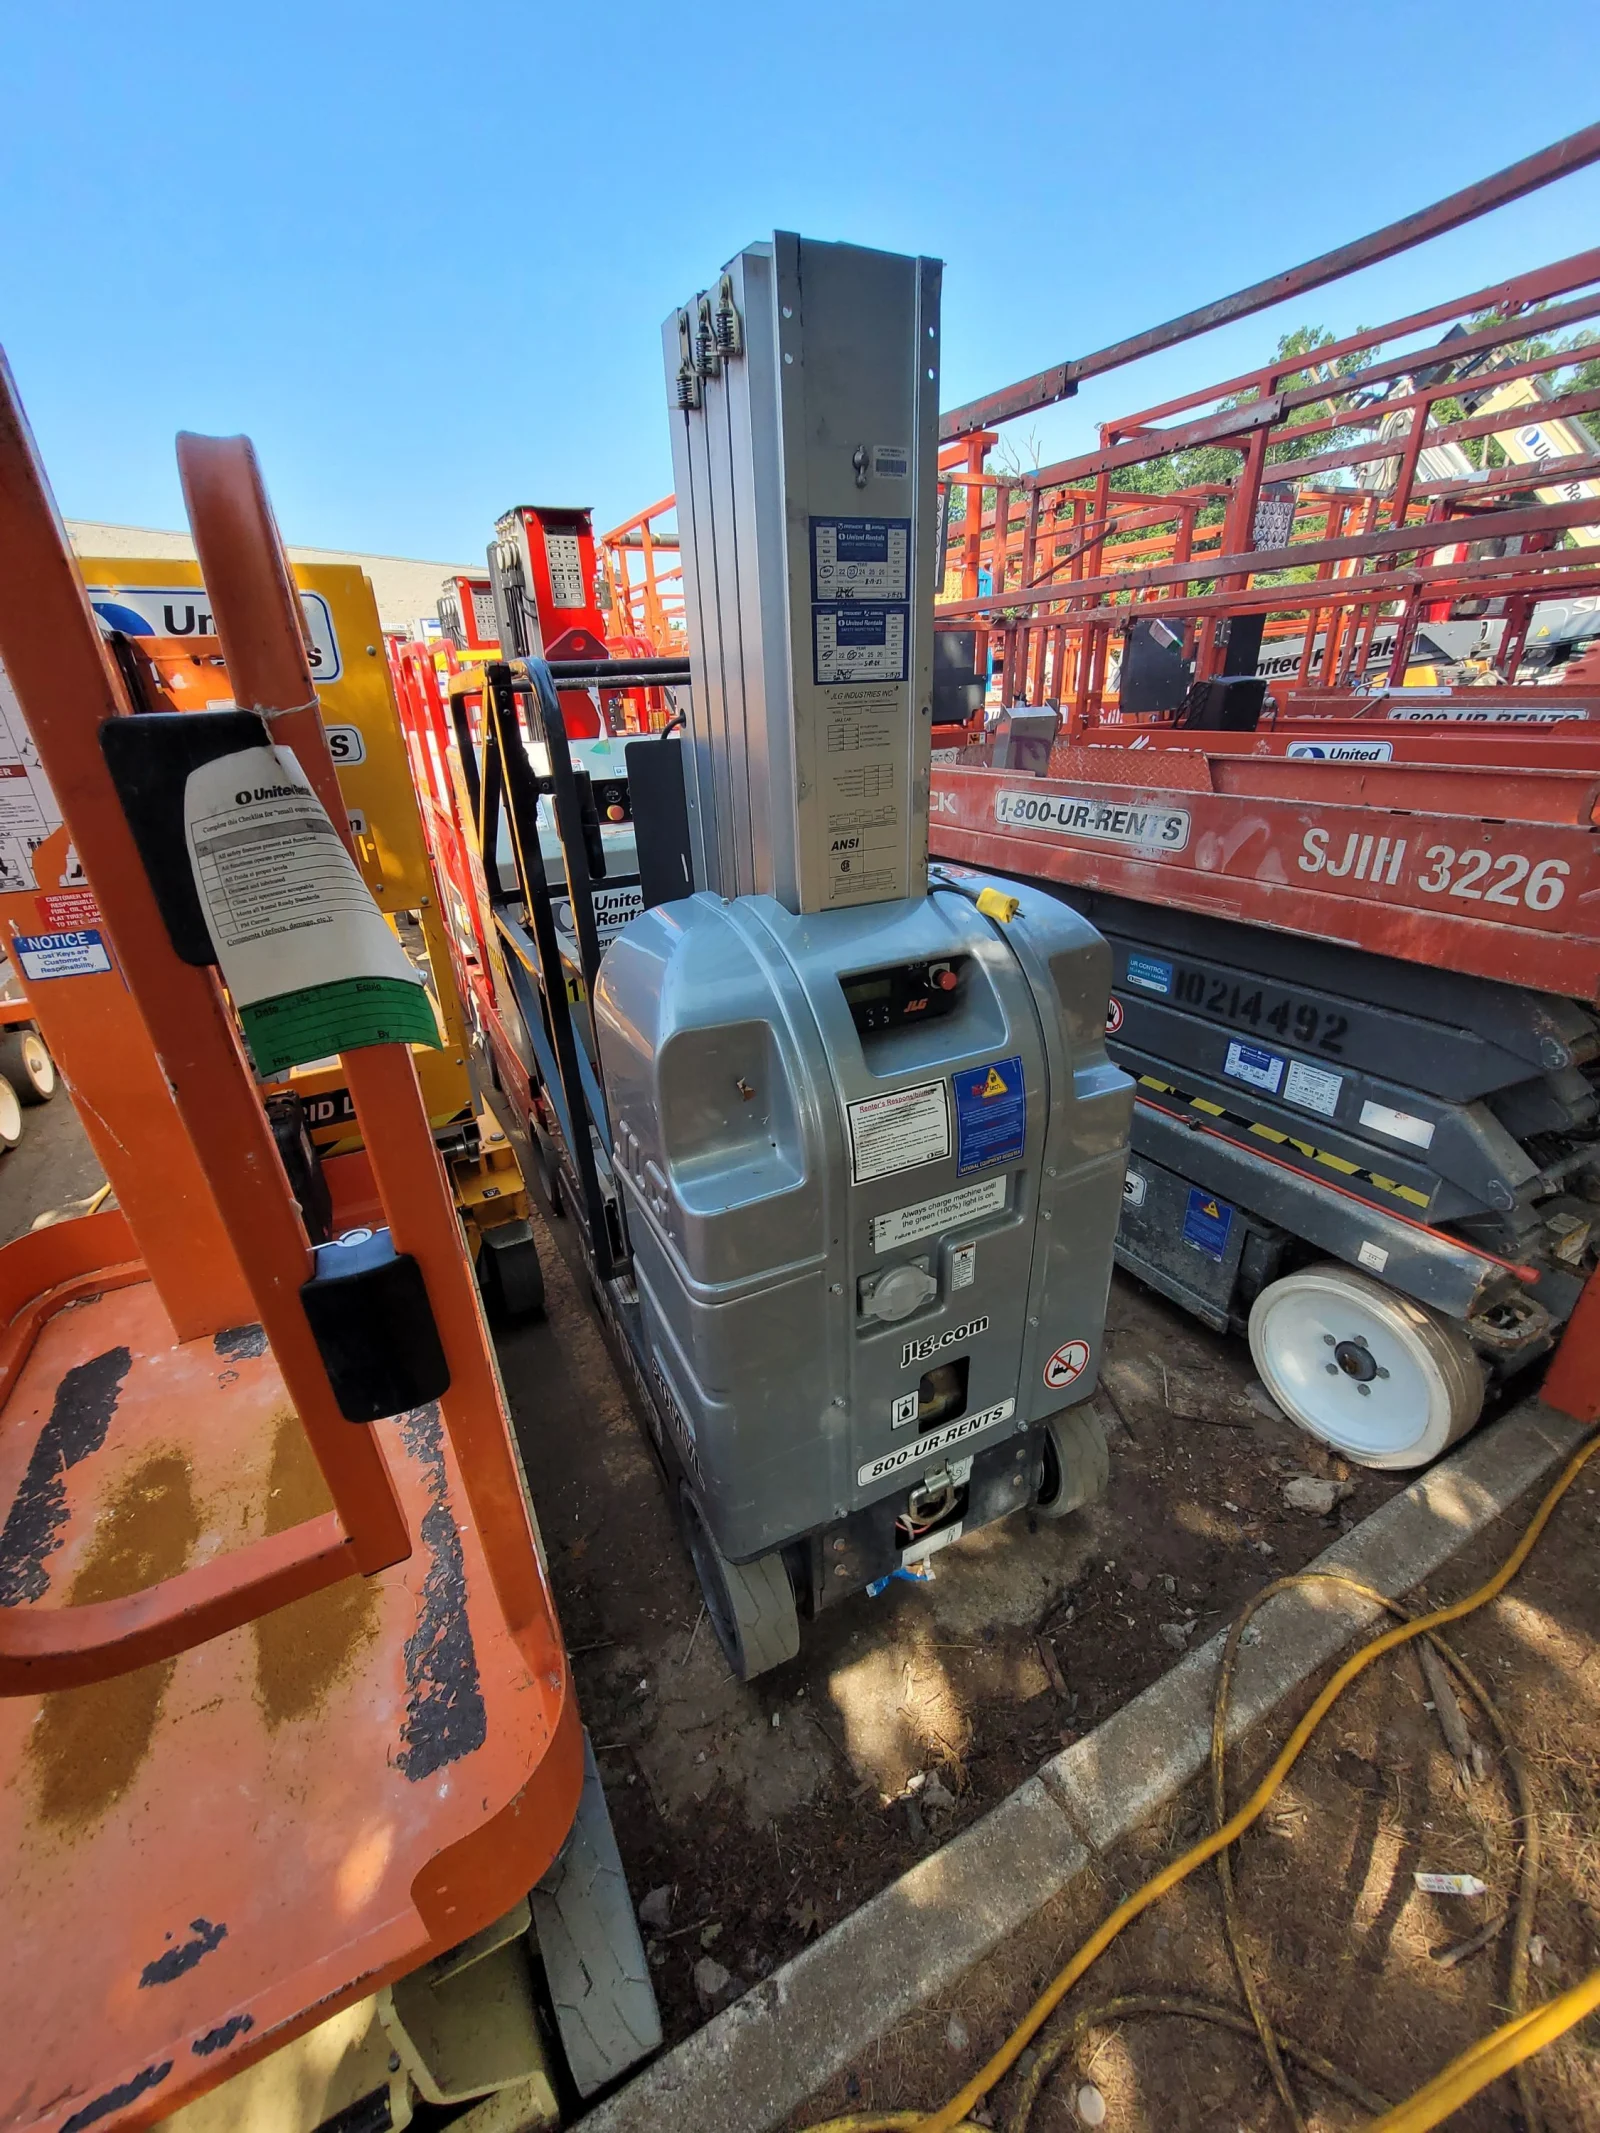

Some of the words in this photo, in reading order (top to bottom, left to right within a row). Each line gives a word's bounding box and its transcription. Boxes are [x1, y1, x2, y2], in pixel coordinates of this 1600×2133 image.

[831, 692, 843, 700] JLG
[844, 691, 881, 699] INDUSTRIES
[1330, 748, 1381, 760] United
[238, 812, 264, 823] Checklist
[1000, 798, 1182, 841] 1-800-UR-RENTS
[831, 838, 859, 851] ANSI
[219, 852, 227, 860] All
[255, 868, 271, 877] proper
[272, 864, 288, 872] levels
[1418, 845, 1570, 911] 3226
[46, 894, 81, 902] CUSTOMER
[260, 902, 277, 911] Rental
[278, 899, 294, 908] Ready
[294, 894, 320, 903] Standards
[251, 917, 270, 926] Current
[27, 932, 88, 950] NOTICE
[227, 932, 261, 948] Comments
[262, 926, 289, 938] (defects,
[289, 920, 316, 932] damage,
[37, 952, 55, 960] Lost
[57, 951, 76, 959] Keys
[44, 956, 87, 966] Customer's
[1139, 963, 1164, 975] CONTROL
[904, 998, 928, 1013] JLG
[1174, 968, 1348, 1053] 10214492
[378, 1030, 390, 1039] By
[860, 1102, 886, 1113] Renter's
[960, 1162, 979, 1173] NATIONAL
[980, 1154, 1001, 1167] EQUIPMENT
[1002, 1150, 1020, 1160] REGISTER
[901, 1207, 927, 1220] Always
[928, 1199, 952, 1212] charge
[953, 1187, 982, 1202] machine
[982, 1182, 996, 1192] until
[902, 1220, 914, 1228] the
[915, 1213, 935, 1225] green
[936, 1202, 961, 1218] (100%)
[962, 1197, 977, 1210] light
[895, 1231, 910, 1240] Failure
[958, 1208, 976, 1218] reduced
[977, 1202, 993, 1212] battery
[902, 1316, 988, 1366] jlg.com
[872, 1406, 1004, 1476] 800-UR-RENTS
